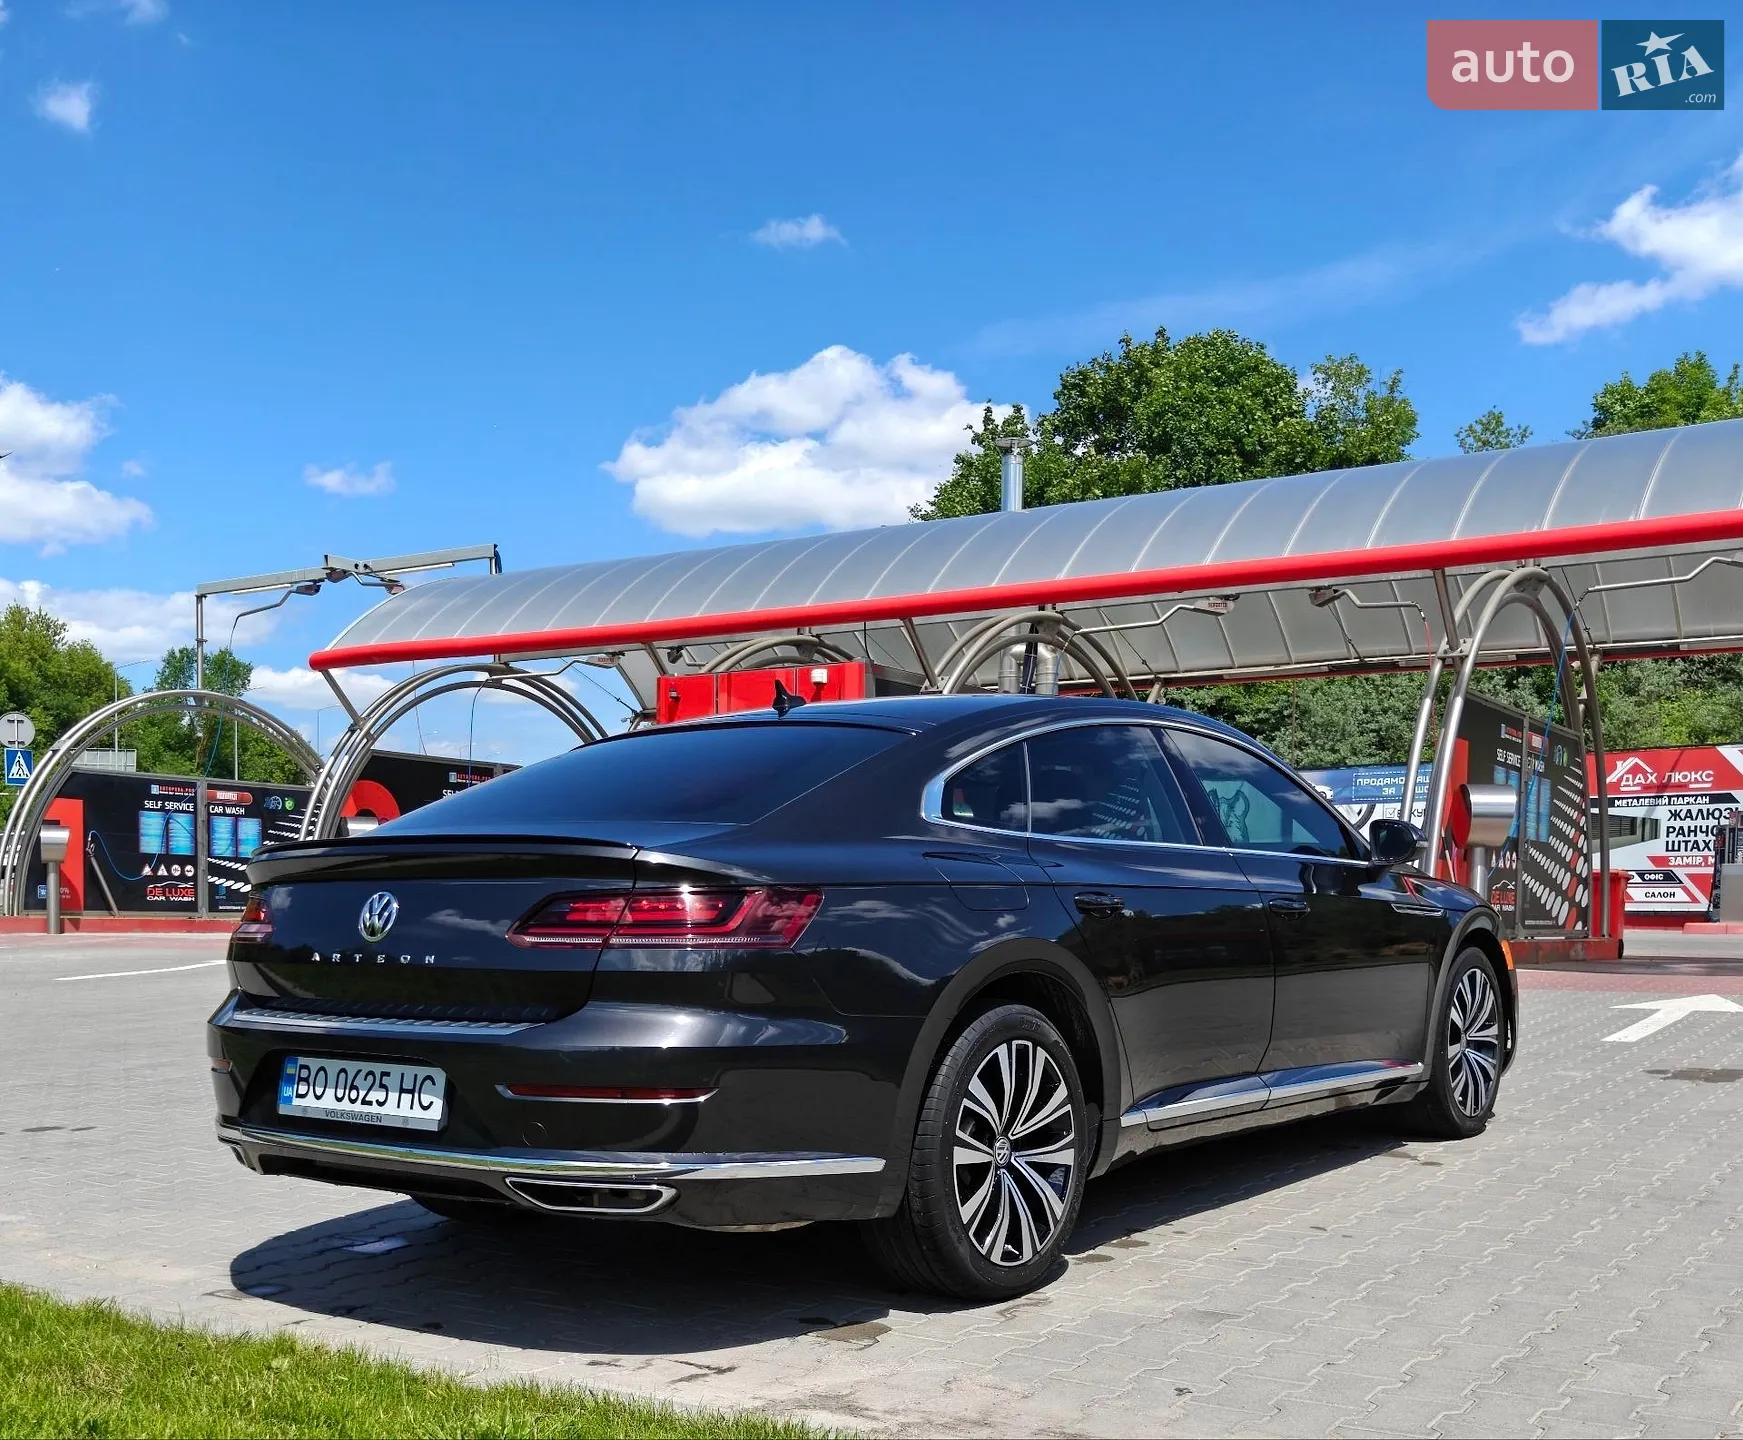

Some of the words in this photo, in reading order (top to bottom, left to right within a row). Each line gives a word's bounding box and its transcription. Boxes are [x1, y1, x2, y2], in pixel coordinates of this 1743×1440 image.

[1620, 772, 1657, 787] ДАХ
[1662, 770, 1714, 783] ЛЮКС
[144, 800, 163, 809] SELF
[165, 801, 195, 811] SERVICE
[1614, 796, 1669, 807] МЕТАЛЕВИЙ
[1670, 796, 1710, 805] ПАРКАН
[209, 805, 223, 814] CAR
[225, 806, 245, 815] WASH
[1667, 807, 1738, 821] ЖАЛЮЗ
[1665, 839, 1715, 852] ШТАХ
[146, 887, 164, 896] DE
[165, 887, 195, 896] LUXE
[1644, 891, 1676, 899] САЛОН
[311, 952, 435, 964] ARTEON
[283, 1086, 293, 1097] UA
[295, 1064, 328, 1100] BO
[334, 1067, 391, 1107] 0625
[397, 1072, 437, 1111] HC
[325, 1110, 382, 1124] VOLKSWAGEN
